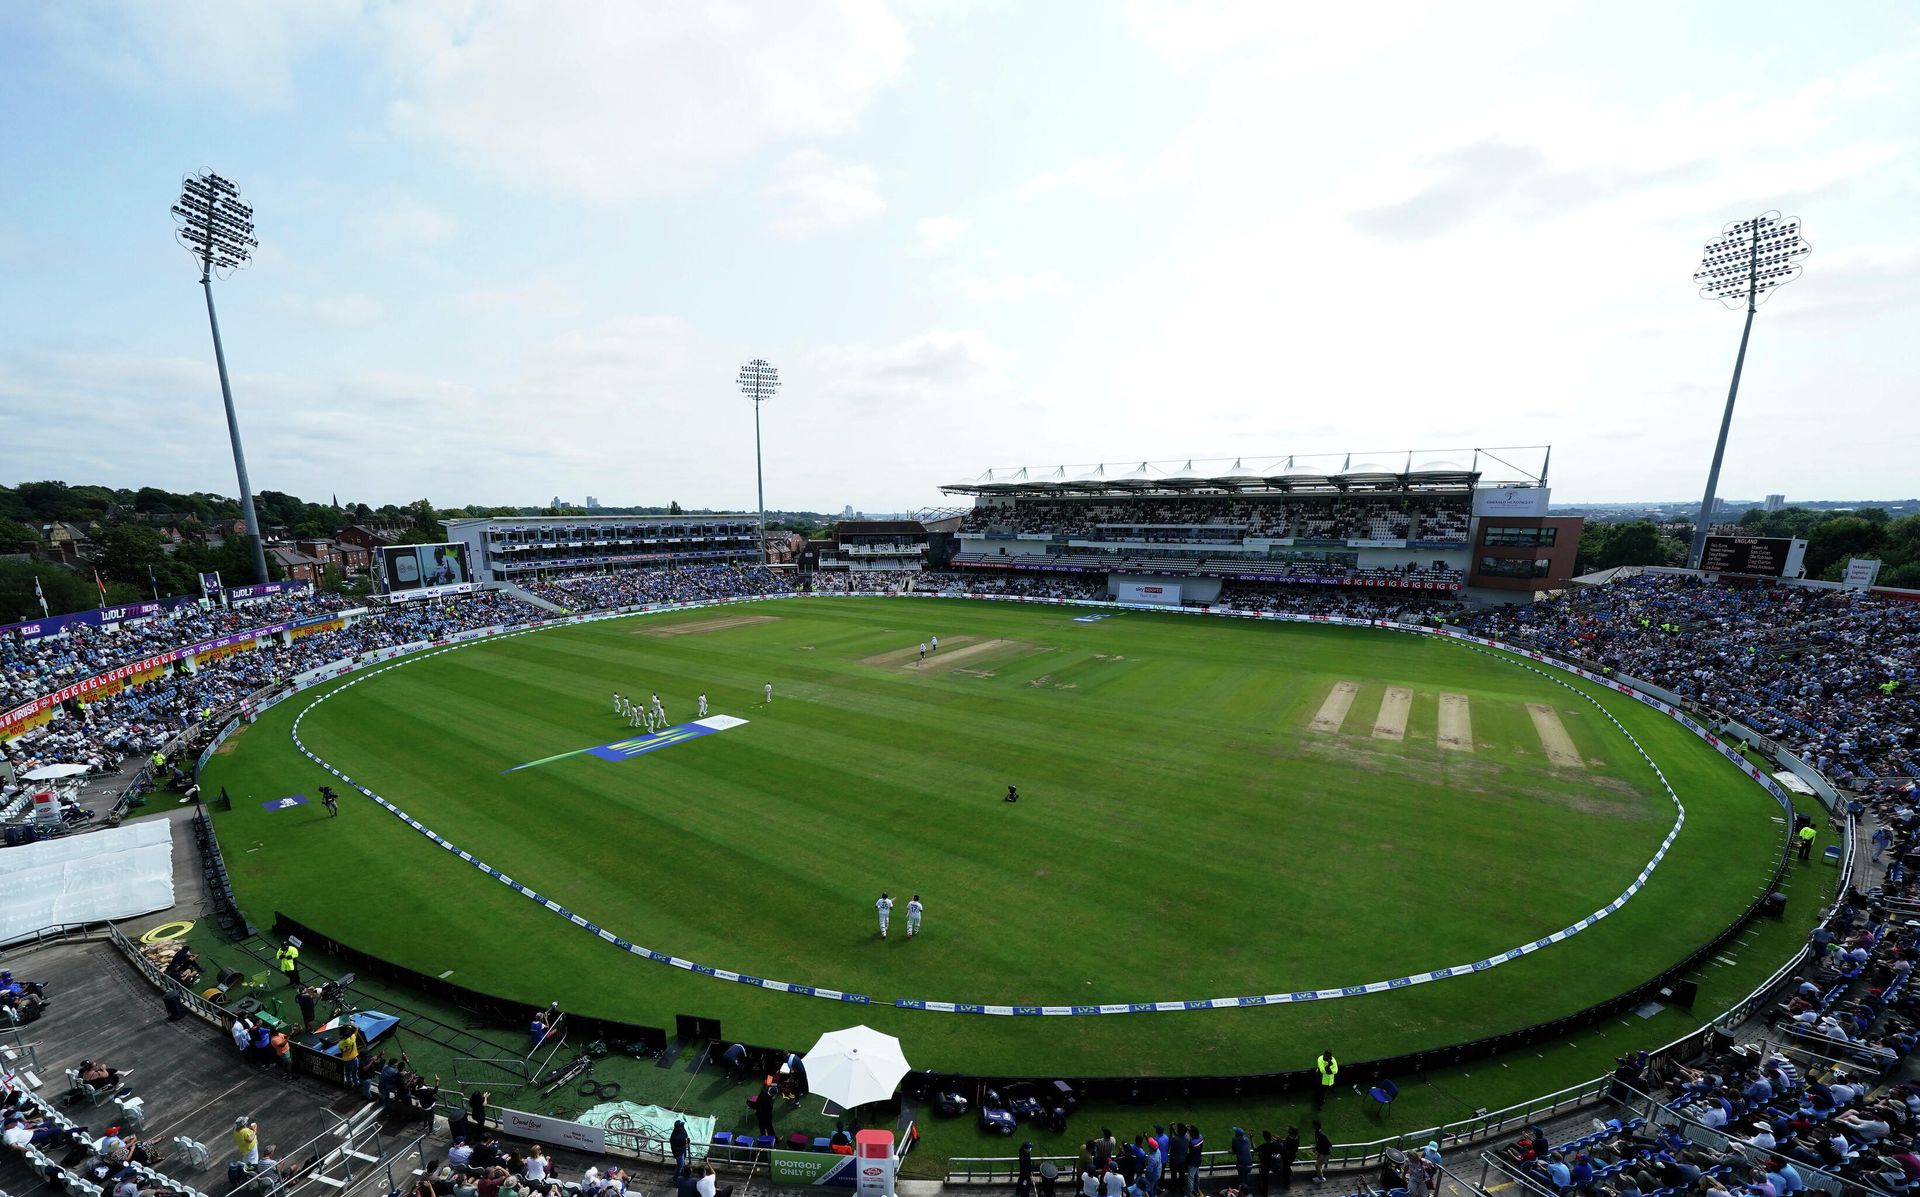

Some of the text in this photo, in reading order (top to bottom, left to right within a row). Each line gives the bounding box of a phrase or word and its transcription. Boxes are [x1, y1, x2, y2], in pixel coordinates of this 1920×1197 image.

[233, 588, 253, 598] WOLF
[101, 608, 126, 621] WOLF
[459, 633, 478, 641] ENGLAND
[1460, 634, 1480, 642] ENGLAND
[404, 645, 423, 654] ENGLAND
[1504, 645, 1522, 654] ENGLAND
[161, 655, 168, 663] IG
[170, 652, 176, 660] IG
[152, 658, 160, 666] IG
[361, 657, 380, 667] ENGLAND
[1552, 660, 1569, 670] ENGLAND
[126, 666, 133, 674] IG
[135, 664, 142, 672] IG
[109, 672, 116, 681] IG
[117, 670, 124, 678] IG
[89, 679, 96, 688] IG
[307, 675, 327, 686] ENGLAND
[1591, 674, 1609, 685] ENGLAND
[71, 686, 78, 696] IG
[80, 682, 87, 692] IG
[52, 694, 59, 704] IG
[62, 690, 69, 700] IG
[266, 694, 283, 707] ENGLAND
[1642, 695, 1660, 708] ENGLAND
[12, 702, 38, 721] VIRUSES
[224, 720, 238, 736] ENGLAND
[1682, 716, 1698, 732] ENGLAND
[1726, 748, 1744, 766] ENGLAND
[1768, 780, 1788, 803] ENGLAND
[512, 1117, 542, 1128] David Lloyd
[775, 1160, 821, 1170] FOOTGOLF
